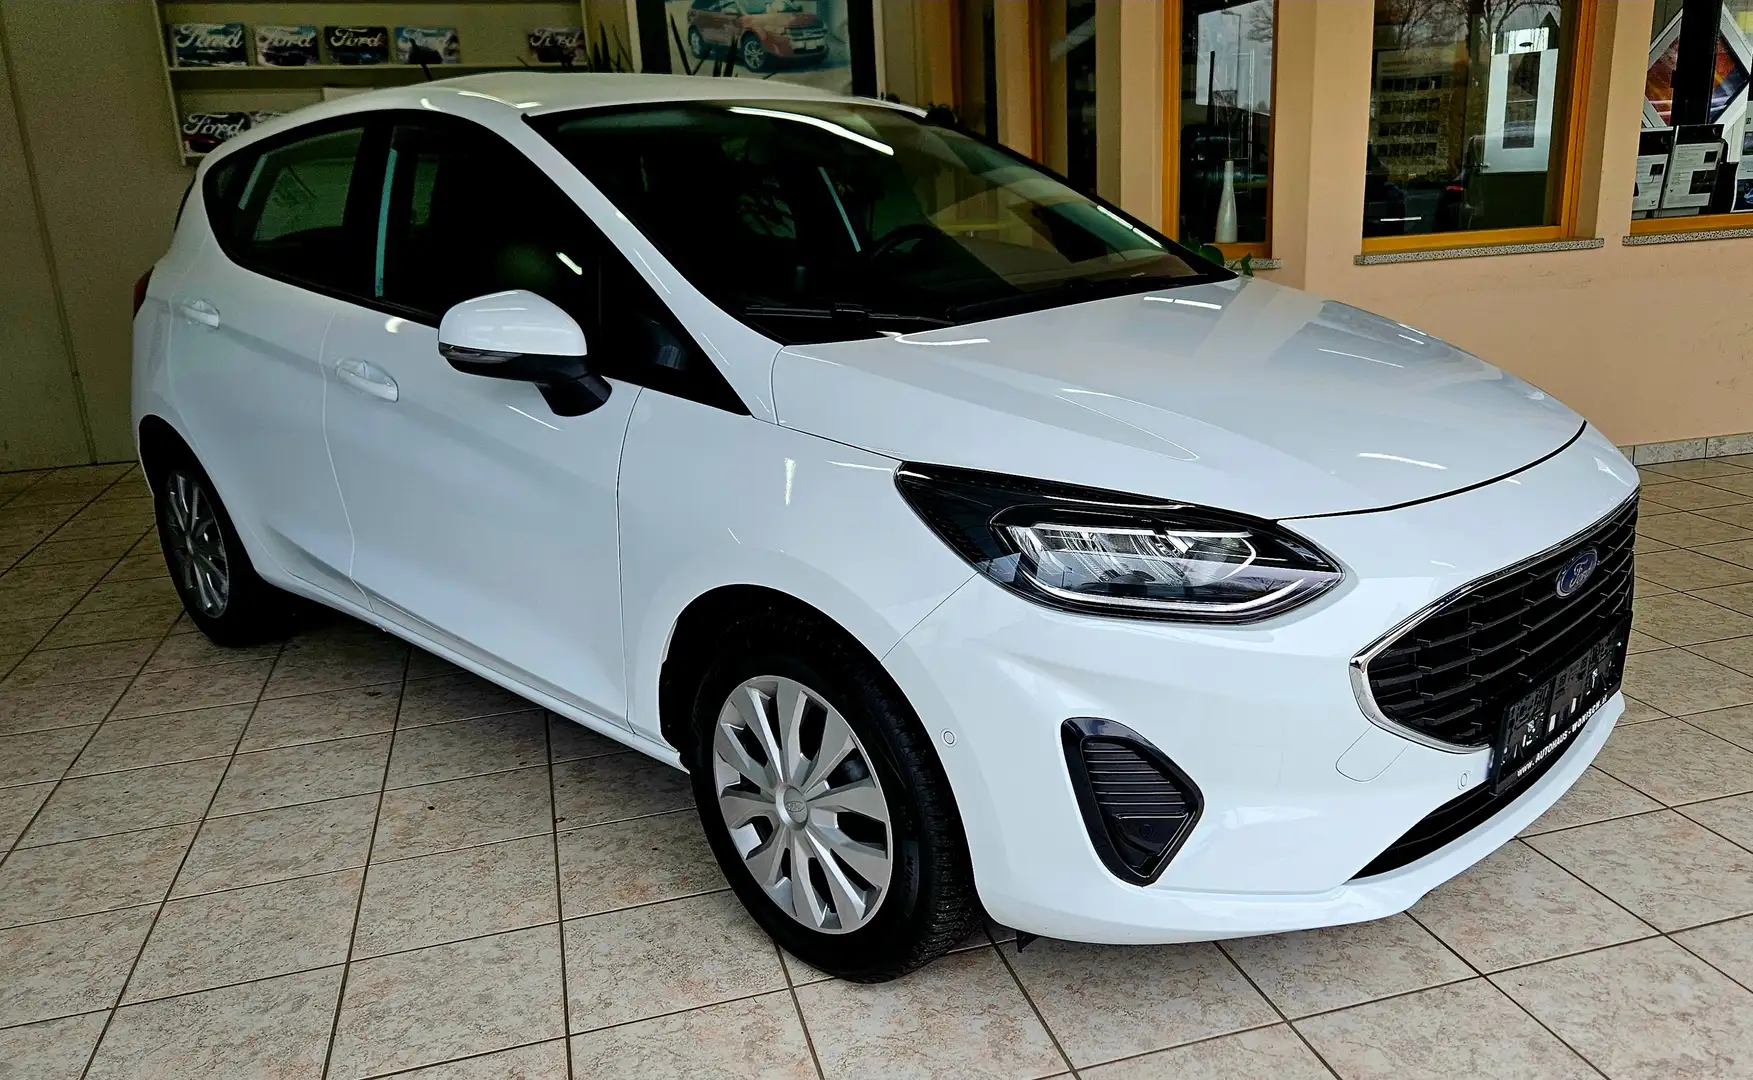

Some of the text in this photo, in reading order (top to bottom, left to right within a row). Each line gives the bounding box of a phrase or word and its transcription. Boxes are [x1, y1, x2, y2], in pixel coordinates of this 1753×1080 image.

[176, 24, 243, 48] Ford
[330, 28, 384, 47] Ford
[530, 27, 581, 48] Ford
[183, 114, 245, 137] Ford
